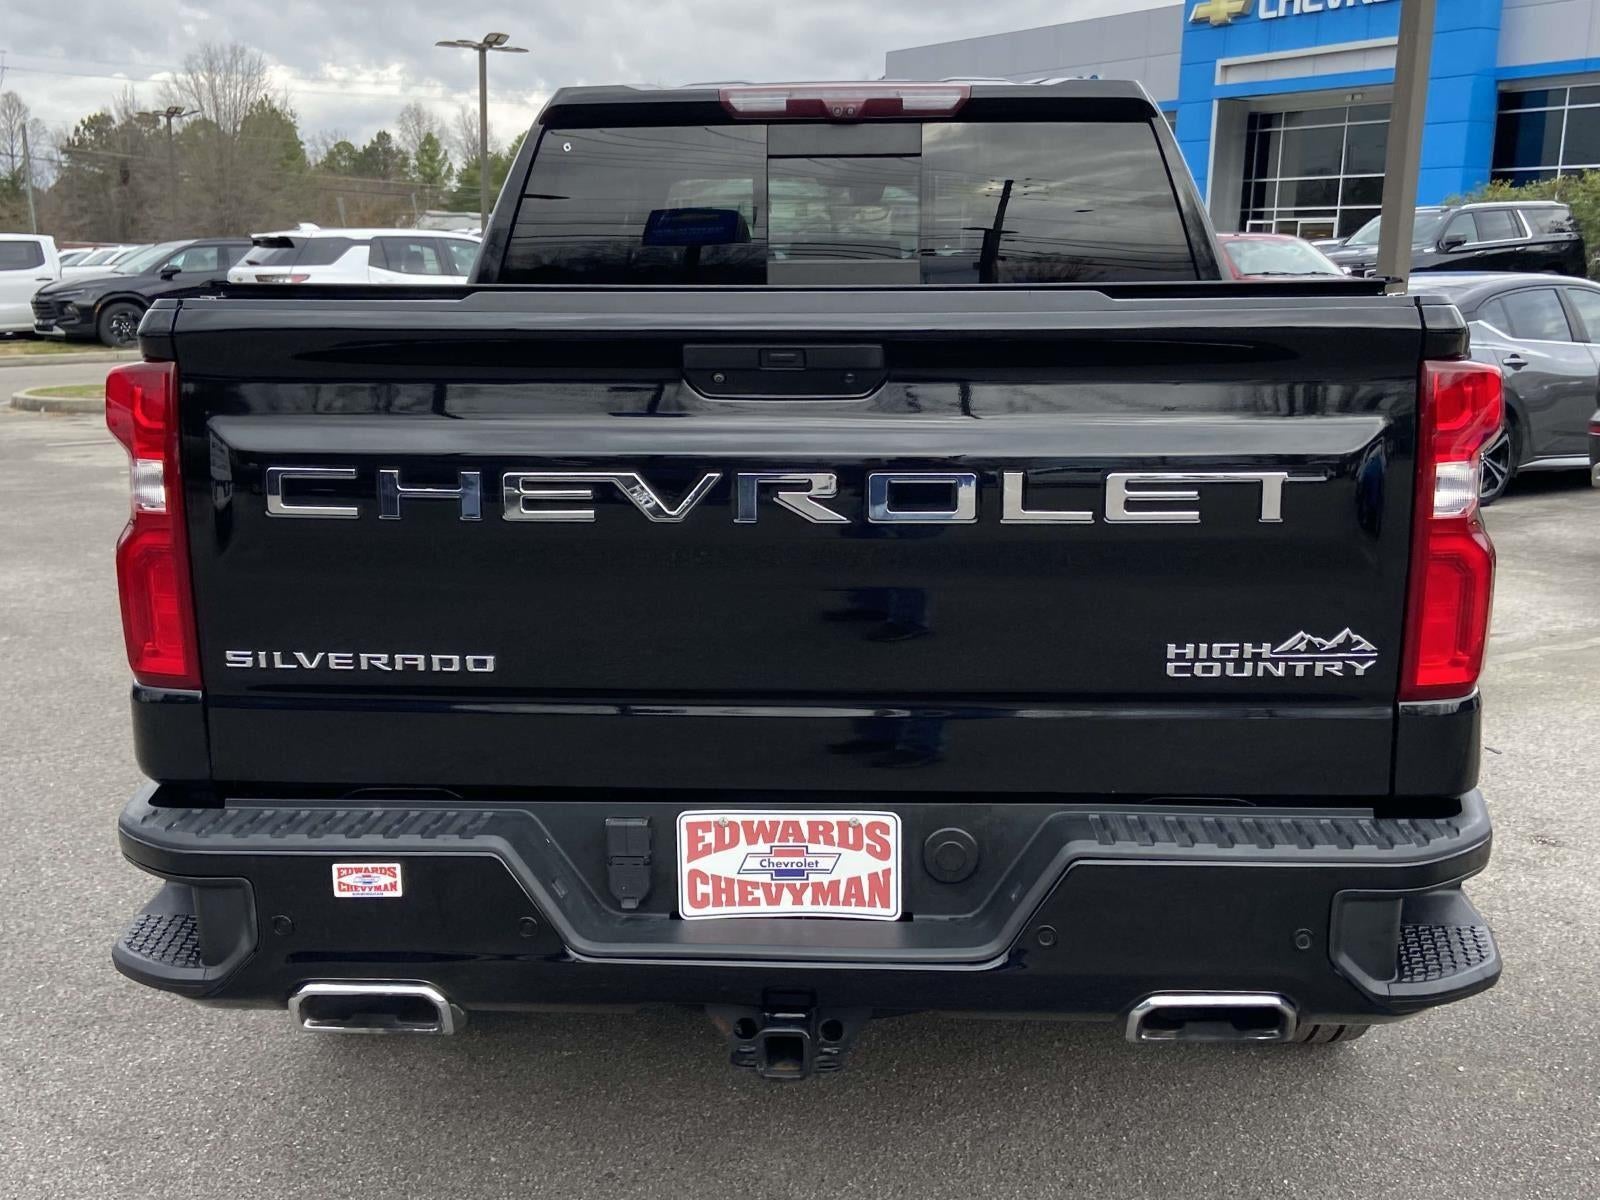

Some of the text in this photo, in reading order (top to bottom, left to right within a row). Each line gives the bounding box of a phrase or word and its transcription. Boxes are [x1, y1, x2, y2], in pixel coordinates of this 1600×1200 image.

[266, 468, 1289, 521] CHEVROLET
[1166, 643, 1271, 659] HIGH
[225, 650, 495, 672] SILVERADO
[1166, 660, 1376, 677] COUNTRY
[686, 820, 892, 864] EDWARDS
[759, 858, 820, 869] Chevrolet
[337, 866, 397, 879] EDWARDS
[337, 881, 398, 892] CHEVYMAN
[687, 868, 892, 909] CHEVYMAN
